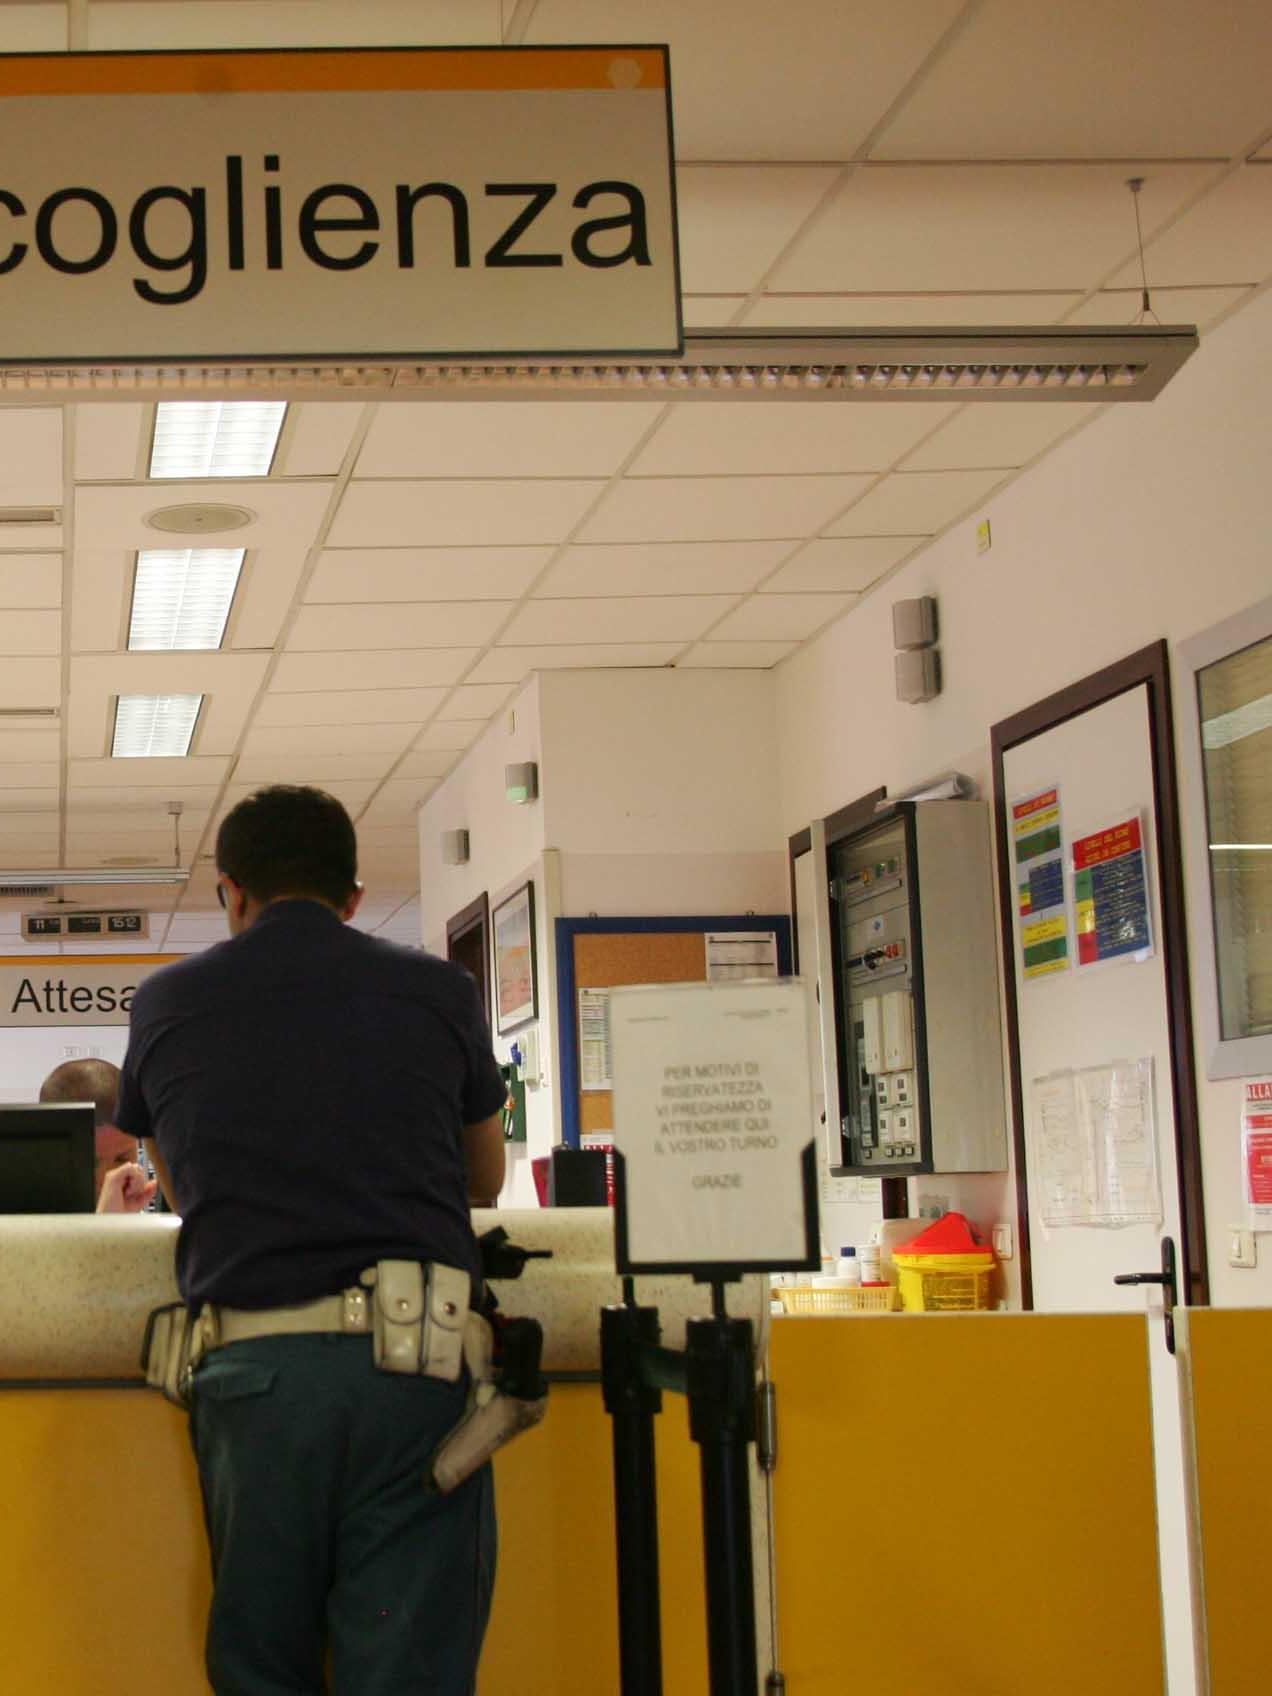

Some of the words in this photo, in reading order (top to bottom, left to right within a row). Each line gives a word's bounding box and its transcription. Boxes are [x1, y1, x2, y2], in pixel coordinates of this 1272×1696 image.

[11, 978, 137, 1013] Attesa
[663, 1065, 691, 1080] PER
[694, 1063, 742, 1079] MOTIVI
[744, 1062, 759, 1076] DI
[661, 1080, 763, 1098] RISERVATEZZA
[656, 1106, 668, 1118] VI
[672, 1101, 754, 1116] PREGHIAMO
[758, 1099, 772, 1112] DI
[660, 1120, 741, 1136] ATTENDERE
[744, 1117, 769, 1132] QUI
[669, 1138, 726, 1153] VOSTRO
[730, 1136, 778, 1151] TURNO
